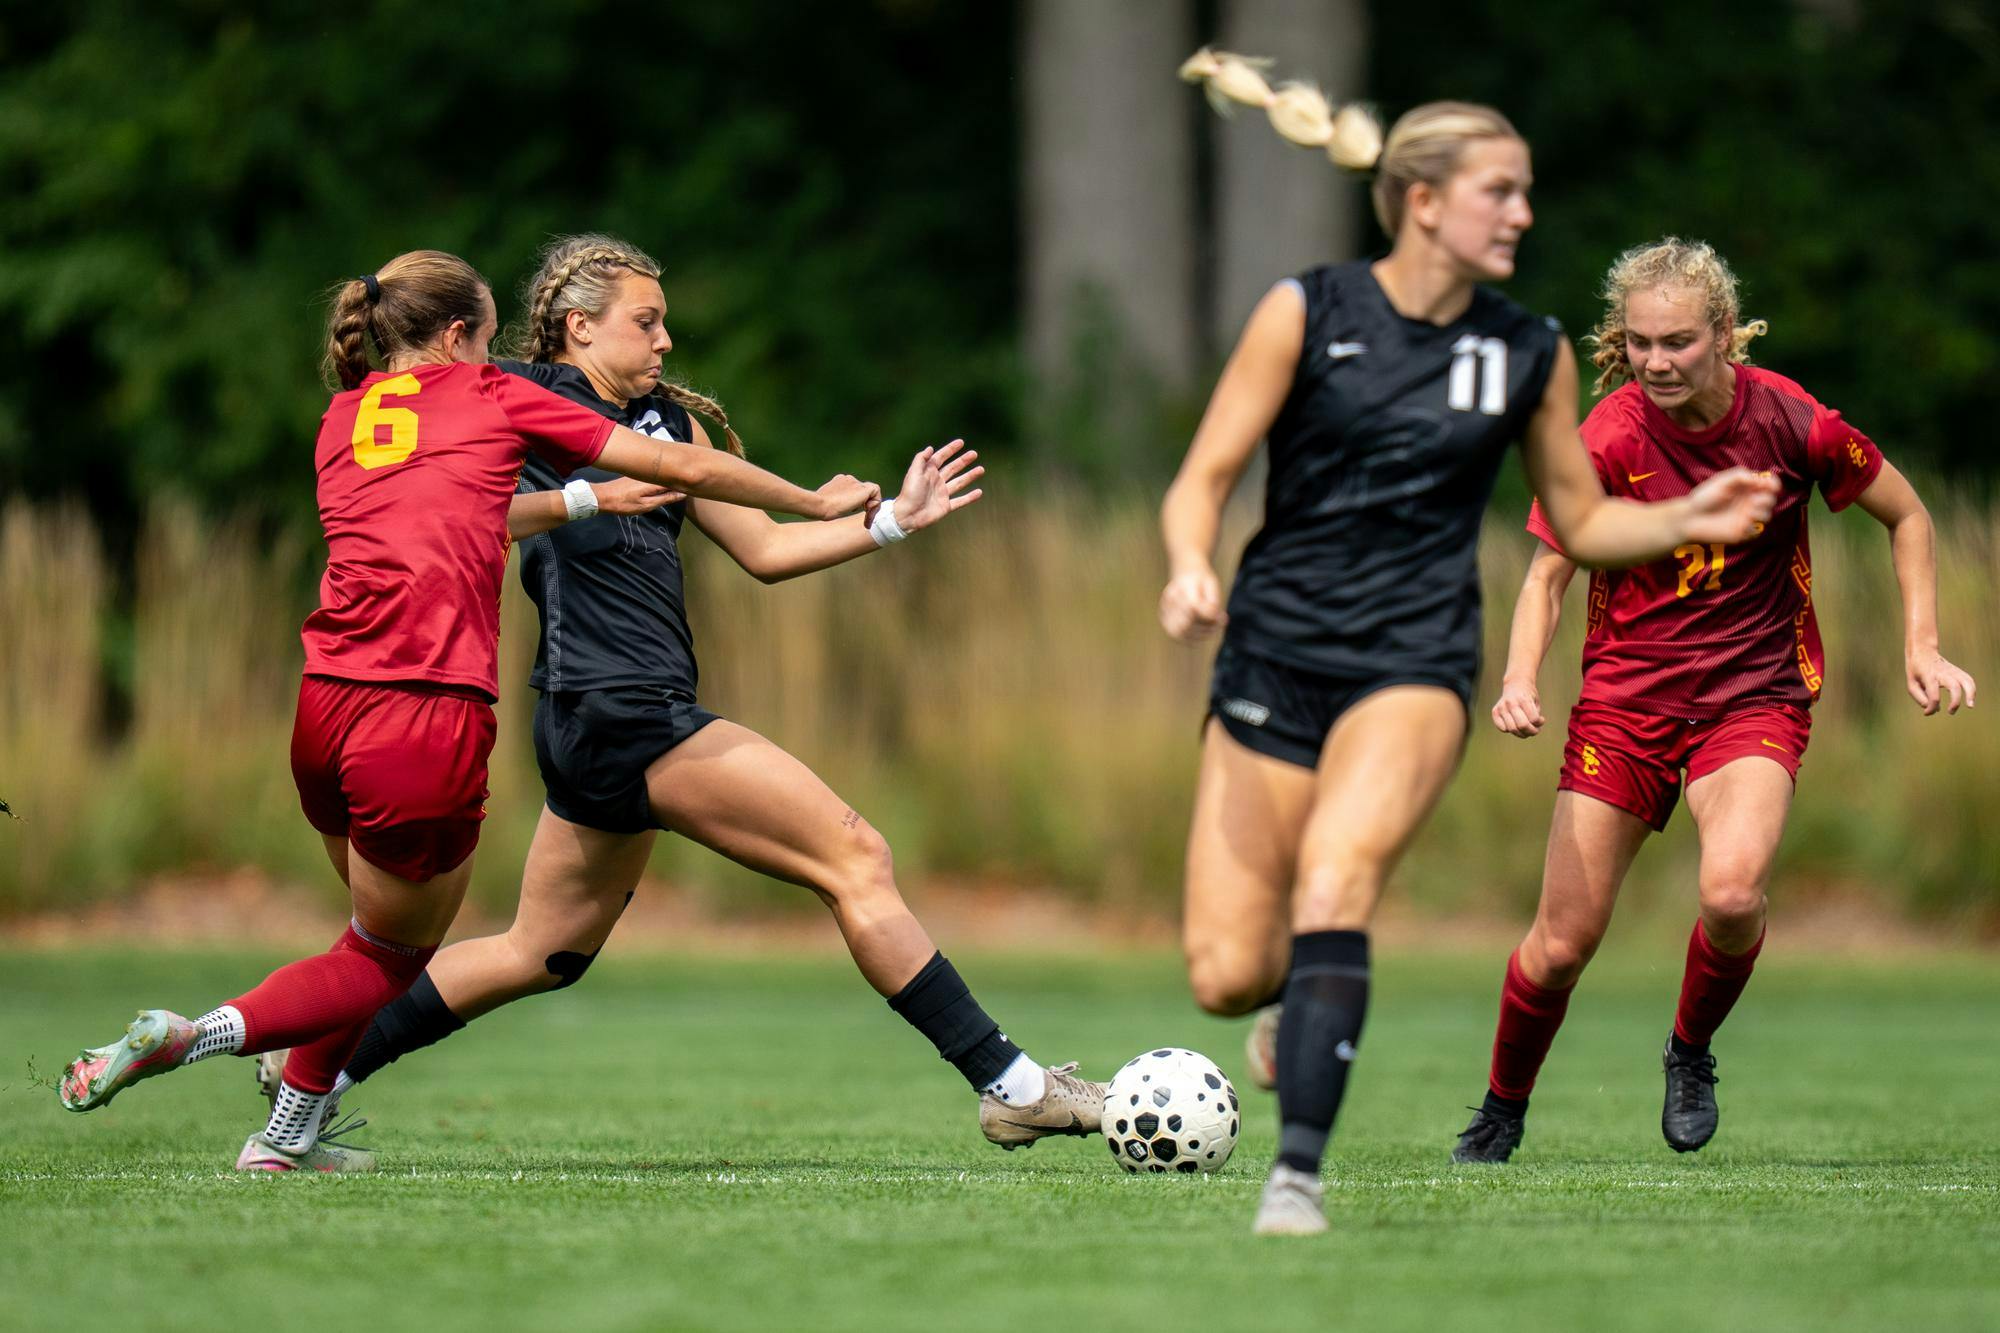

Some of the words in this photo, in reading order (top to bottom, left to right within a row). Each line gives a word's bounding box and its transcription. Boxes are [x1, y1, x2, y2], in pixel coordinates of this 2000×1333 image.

[1448, 334, 1507, 415] 11
[352, 373, 421, 470] 6
[1674, 543, 1725, 598] 21
